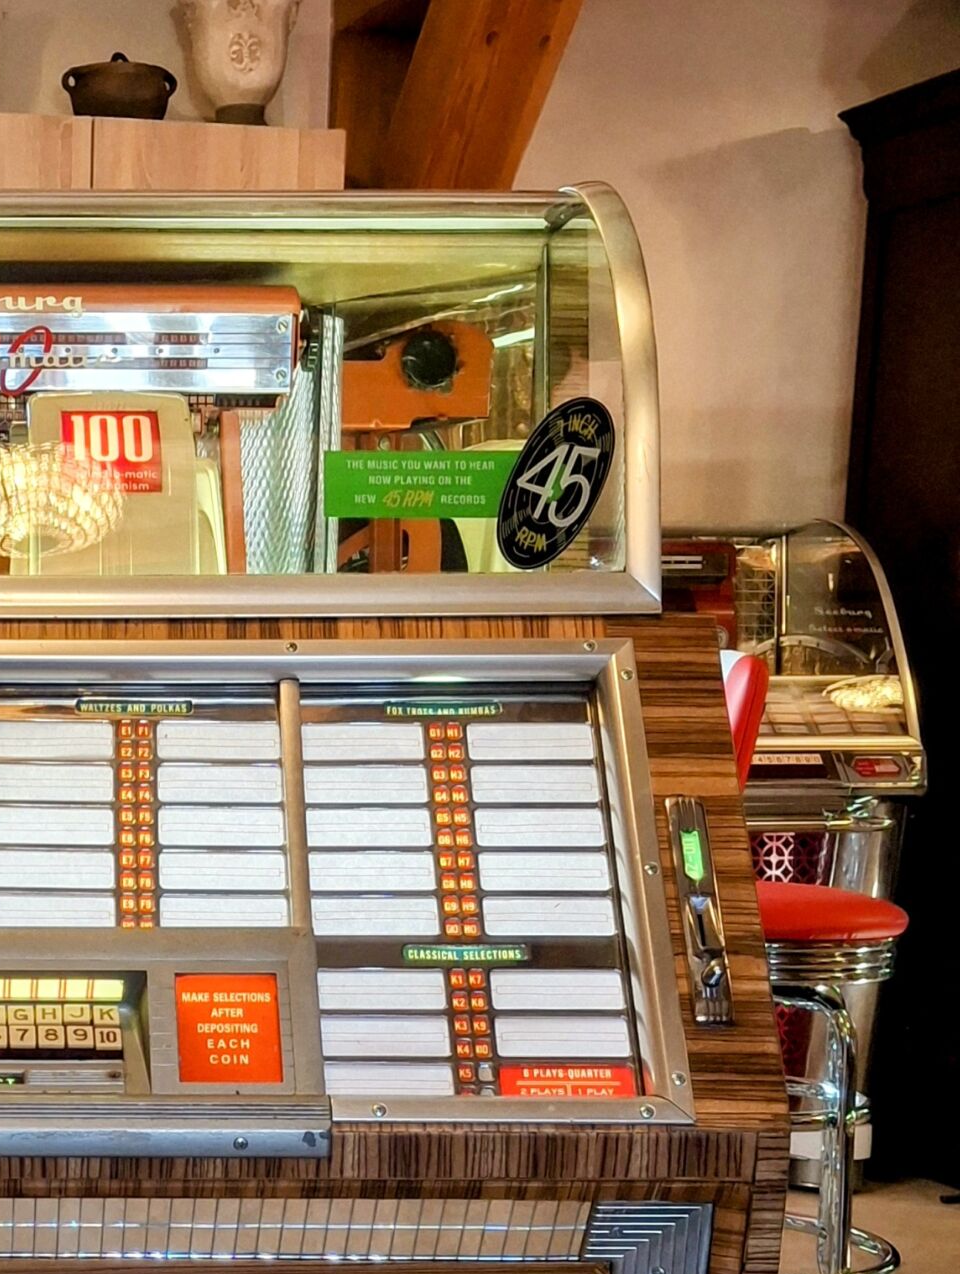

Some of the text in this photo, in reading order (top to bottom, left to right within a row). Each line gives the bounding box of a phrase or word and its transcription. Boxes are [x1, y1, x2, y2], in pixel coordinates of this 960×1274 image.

[71, 415, 153, 462] 100
[346, 460, 495, 470] THE MUSIC YOU WANT TO HEAR
[369, 475, 472, 485] NOW PLAYING ON THE
[517, 444, 601, 527] 45
[354, 490, 486, 508] NEW 45 RPM RECORDS
[515, 525, 547, 553] RPM
[80, 703, 187, 713] WALTZES AND POLKAS
[387, 706, 403, 715] FOX
[121, 727, 148, 736] E1 F1
[429, 728, 458, 738] G1 H1
[120, 747, 149, 757] E2 F2
[448, 749, 461, 759] H2
[450, 771, 463, 780] H3
[121, 790, 133, 800] E4
[452, 792, 465, 801] H4
[408, 949, 522, 960] CLASSICAL SELECTIONS
[450, 975, 481, 985] K1 K7
[181, 992, 271, 1002] MAKE SELECTIONS
[452, 998, 484, 1007] K2 K8
[13, 1008, 29, 1021] G
[41, 1008, 56, 1020] H
[69, 1007, 84, 1018] J
[99, 1008, 115, 1021] K
[211, 1008, 244, 1018] AFTER
[197, 1023, 258, 1033] DEPOSITING
[454, 1021, 487, 1031] K3 K9
[15, 1029, 29, 1041] 7
[44, 1029, 59, 1041] 8
[73, 1028, 88, 1041] 9
[99, 1030, 117, 1043] 10
[207, 1039, 250, 1049] EACH
[456, 1045, 470, 1054] K4
[209, 1054, 249, 1065] COIN
[459, 1068, 472, 1078] K5
[530, 1088, 565, 1096] PLAYS
[587, 1088, 615, 1096] PLAY
